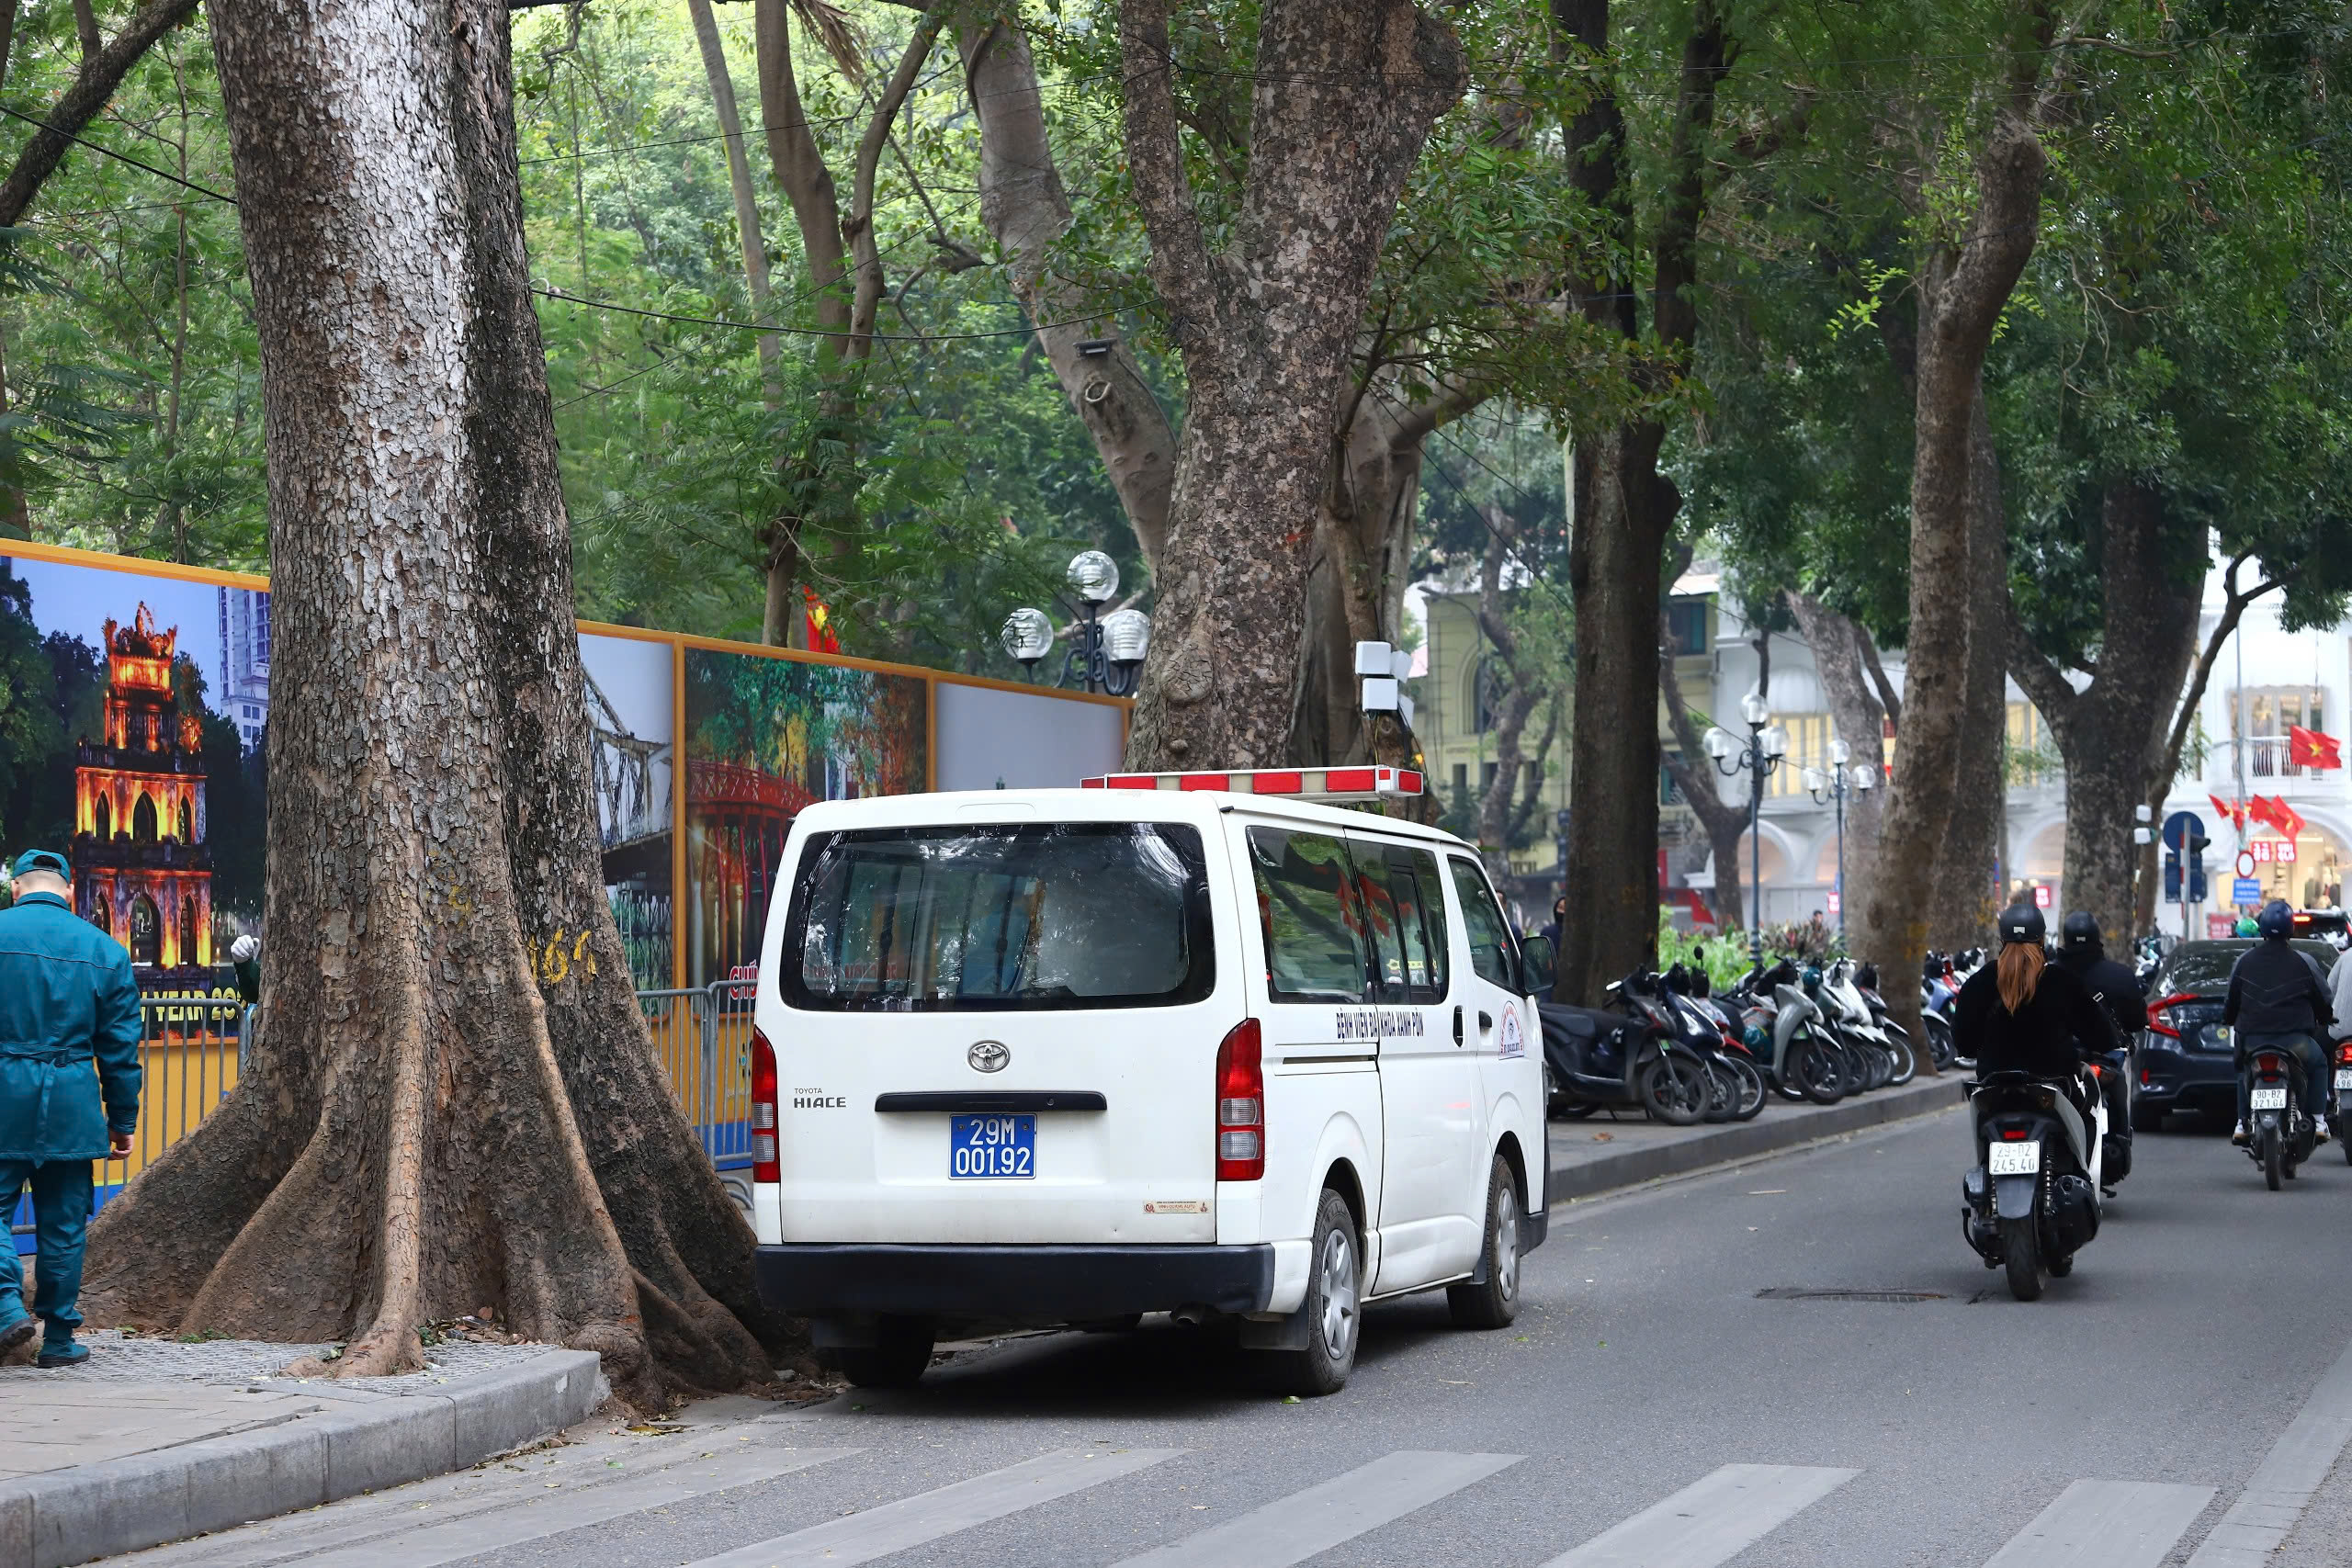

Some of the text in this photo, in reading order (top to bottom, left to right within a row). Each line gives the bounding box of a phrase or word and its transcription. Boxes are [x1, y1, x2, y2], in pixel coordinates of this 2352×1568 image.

[153, 989, 208, 1022] YEAR
[211, 987, 242, 1021] 20
[1379, 1010, 1396, 1037] KHOA
[1396, 1010, 1412, 1037] XANH
[794, 1097, 846, 1109] HIACE
[2256, 1090, 2282, 1100] 90-B2
[970, 1118, 1015, 1145] 29M
[956, 1146, 1031, 1175] 001.92
[1997, 1144, 2031, 1157] 29-D2
[1993, 1158, 2035, 1173] 245.40
